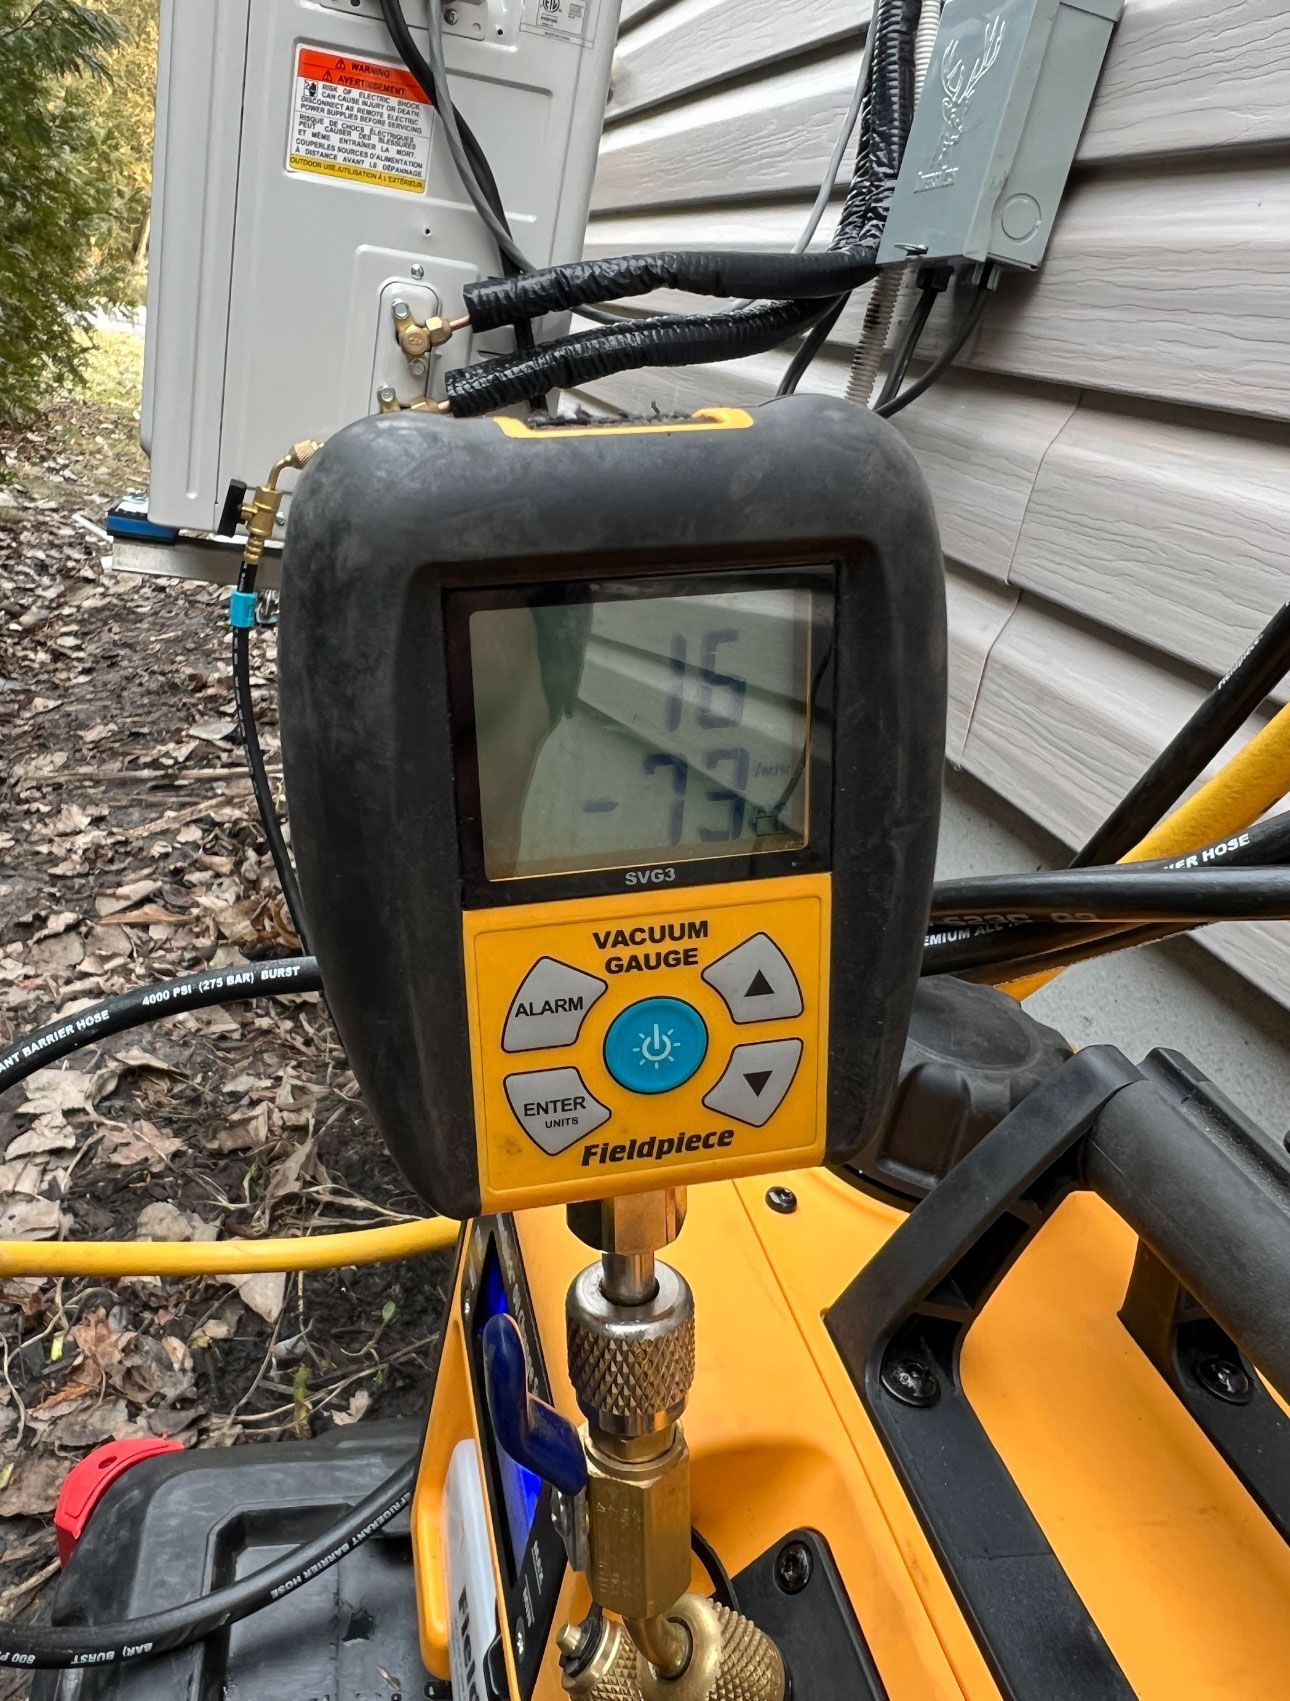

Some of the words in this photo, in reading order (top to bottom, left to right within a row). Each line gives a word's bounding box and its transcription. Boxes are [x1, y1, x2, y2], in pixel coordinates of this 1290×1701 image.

[351, 62, 390, 79] WARNING
[322, 84, 338, 93] RISK
[358, 92, 391, 104] ELECTRIC
[337, 75, 406, 95] AVERTISSEMENT
[301, 96, 343, 110] DISCONNECT
[357, 107, 384, 119] REMOTE
[387, 114, 419, 126] ELECTRIC
[322, 92, 336, 100] CAN
[337, 95, 360, 105] CAUSE
[361, 100, 385, 110] INJURY
[386, 105, 396, 113] OR
[299, 113, 324, 125] RISQUE
[329, 120, 339, 128] DE
[341, 123, 364, 133] CHOCS
[300, 103, 325, 114] POWER
[326, 109, 359, 121] SUPPLIES
[360, 116, 386, 127] BEFORE
[387, 121, 422, 134] SERVICING
[298, 121, 316, 130] PEUT
[325, 126, 352, 137] CAUSER
[358, 133, 372, 141] DES
[378, 137, 416, 150] BLESSURES
[305, 148, 338, 161] DISTANCE
[342, 156, 365, 166] AVANT
[336, 146, 368, 159] SOURCES
[369, 152, 423, 169] D'ALIMENTATION
[381, 145, 390, 153] LA
[290, 156, 322, 169] OUTDOOR
[378, 173, 383, 181] À
[665, 629, 747, 732] 16
[1202, 833, 1251, 862] HOSE
[624, 867, 676, 886] SVG3
[592, 920, 709, 950] VACUUM
[604, 948, 699, 975] GAUGE
[21, 1024, 76, 1057] BARRIER
[75, 1009, 110, 1031] HOSE
[142, 990, 170, 1006] 4000
[172, 984, 192, 998] PSI
[198, 976, 224, 993] (275
[226, 971, 254, 986] BAR)
[260, 965, 301, 980] BURST
[515, 996, 584, 1019] ALARM
[523, 1096, 587, 1117] ENTER
[545, 1116, 579, 1129] UNITS
[581, 1128, 735, 1167] Fieldpiece
[302, 1543, 350, 1578] BARRIER
[71, 1650, 116, 1665] BURST
[122, 1642, 154, 1658] BAR)
